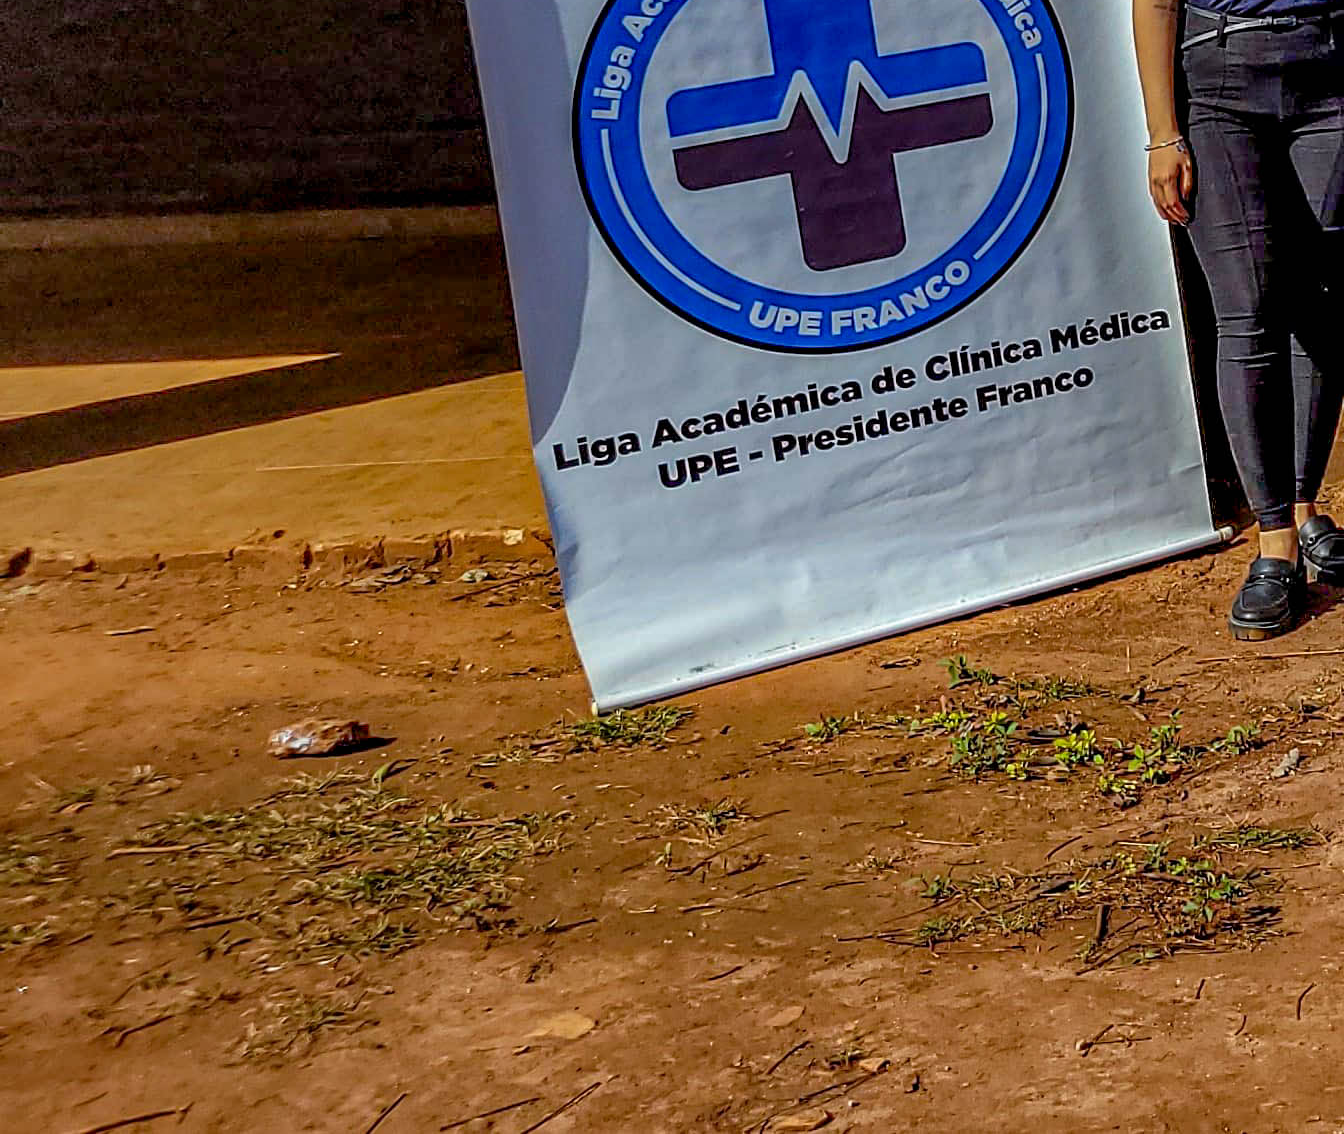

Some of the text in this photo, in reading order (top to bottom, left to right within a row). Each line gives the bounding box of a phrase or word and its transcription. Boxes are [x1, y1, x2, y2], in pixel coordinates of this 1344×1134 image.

[591, 45, 636, 120] Liga
[748, 260, 970, 337] UPE FRANCO
[552, 309, 1171, 471] Liga Académica de Clínica Médica
[657, 446, 741, 488] UPE
[771, 394, 969, 464] Presidente
[975, 366, 1095, 413] Franco
